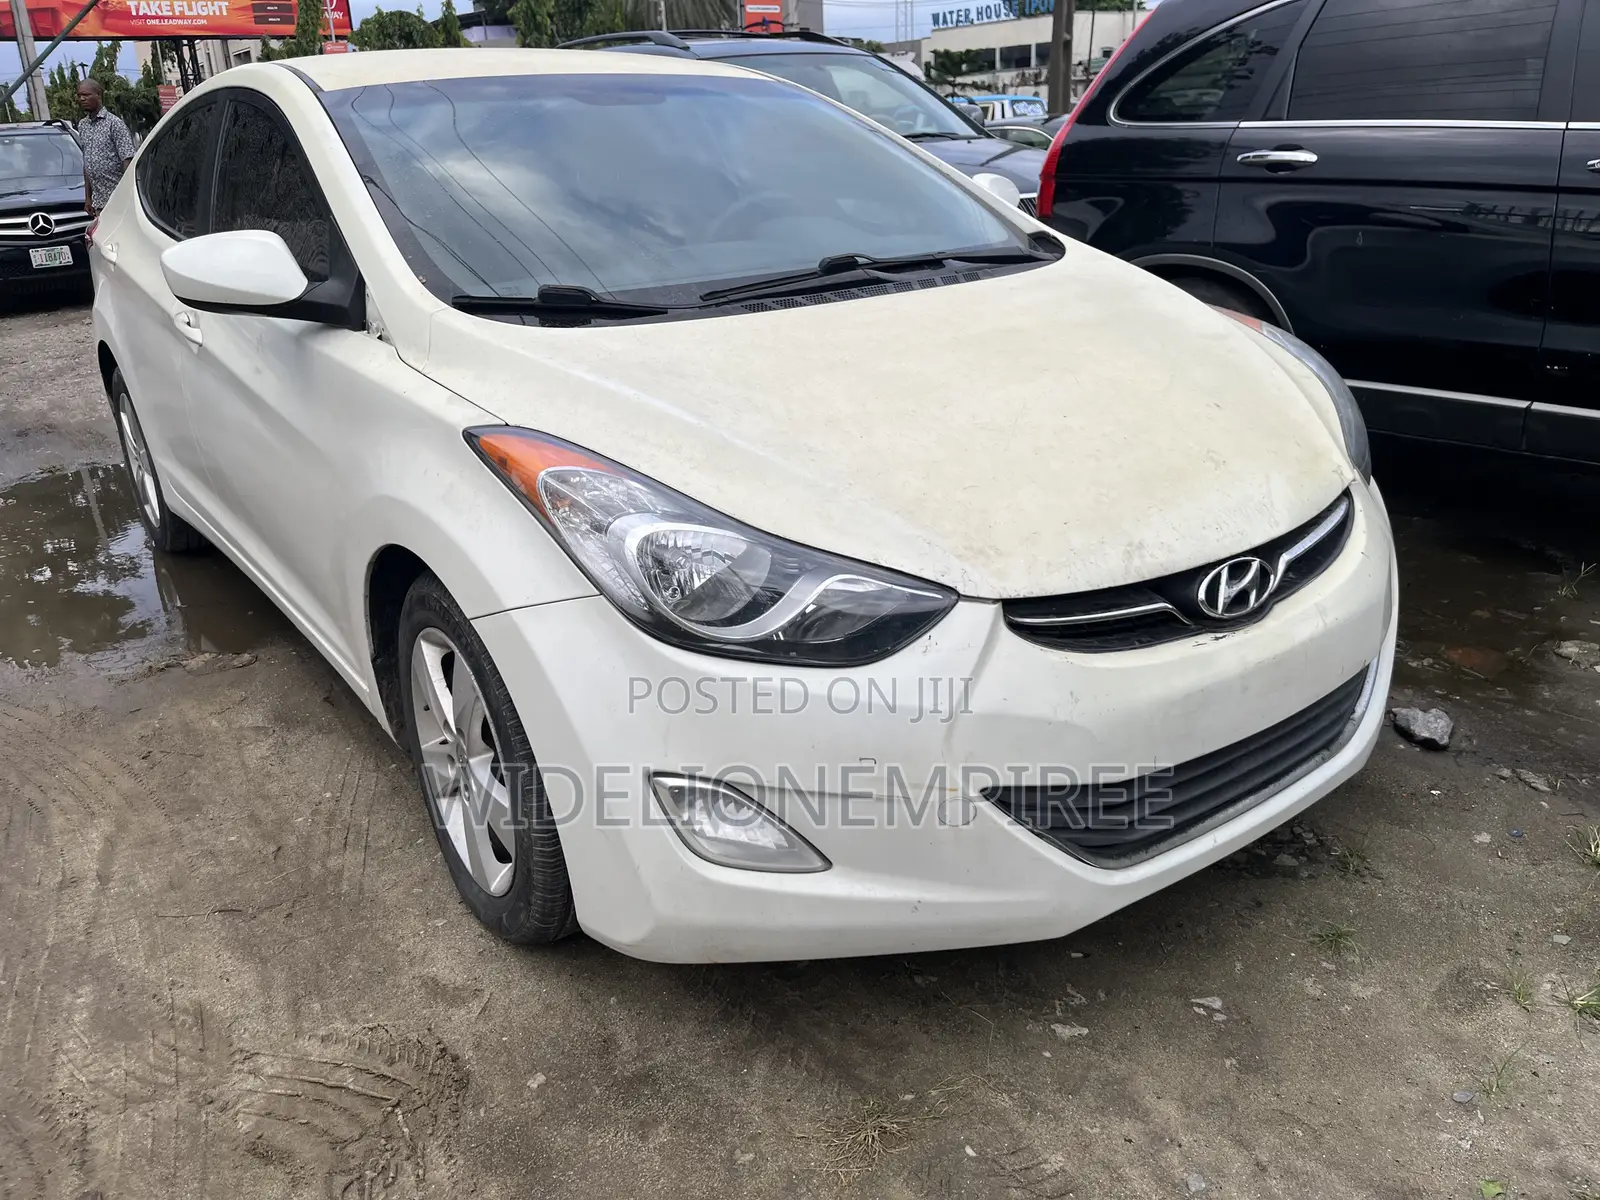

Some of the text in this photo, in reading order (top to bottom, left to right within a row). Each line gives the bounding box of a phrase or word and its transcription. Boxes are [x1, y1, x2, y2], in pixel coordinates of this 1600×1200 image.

[127, 1, 229, 16] TAKE FLIGHT
[932, 8, 971, 27] WATER
[976, 0, 1019, 20] HOUSE
